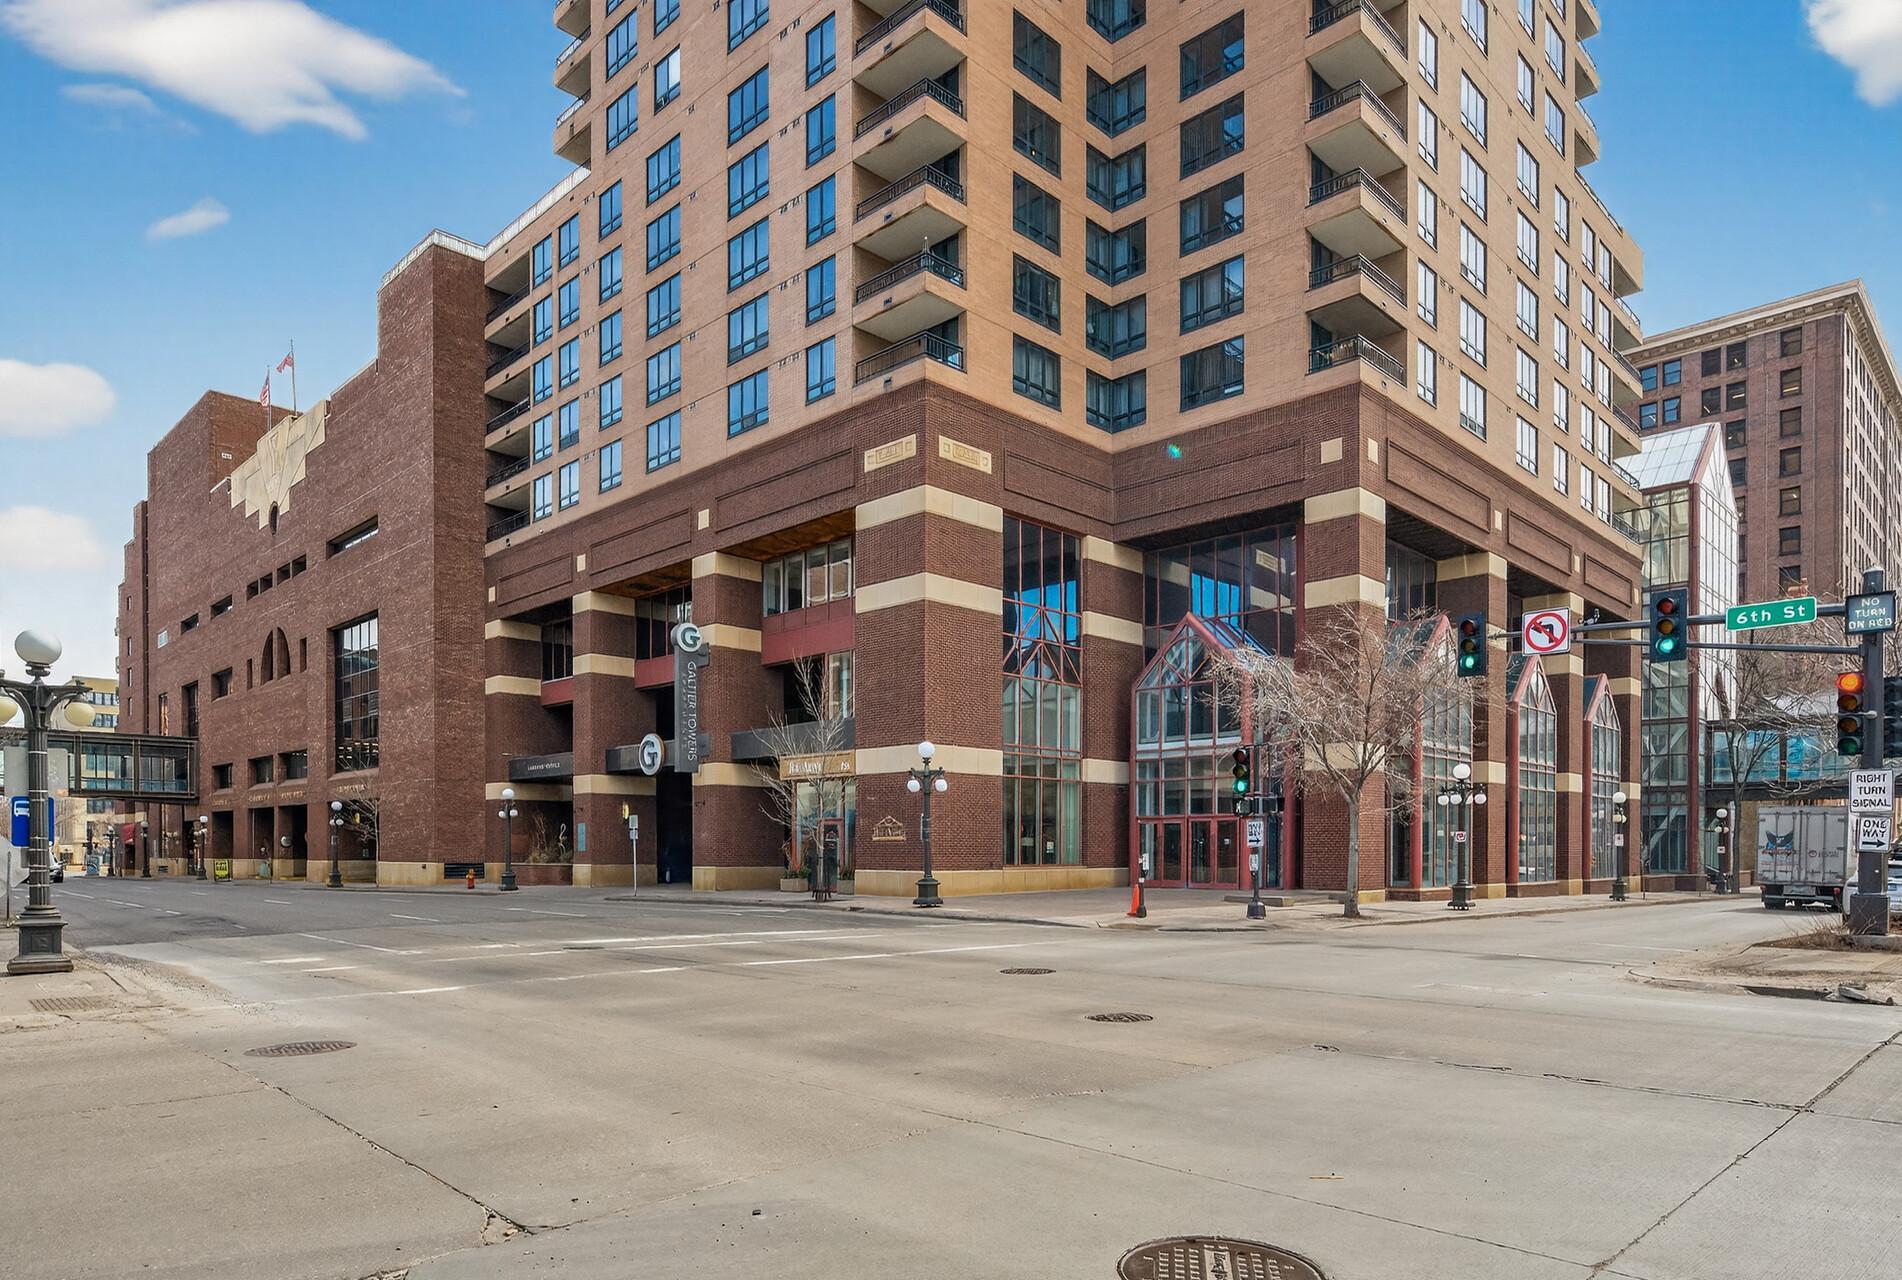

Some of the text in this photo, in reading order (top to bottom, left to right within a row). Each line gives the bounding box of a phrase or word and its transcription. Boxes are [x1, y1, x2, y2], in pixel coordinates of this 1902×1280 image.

[1861, 597, 1880, 607] NO
[1736, 604, 1806, 624] 6th St
[1855, 608, 1886, 618] TURN
[1848, 620, 1865, 629] ON
[681, 626, 700, 648] G
[640, 740, 658, 770] G
[1856, 773, 1888, 783] RIGHT
[1857, 786, 1886, 795] TURN
[1852, 798, 1892, 808] SIGNAL
[1863, 819, 1887, 828] ONE
[1863, 829, 1887, 838] WAY
